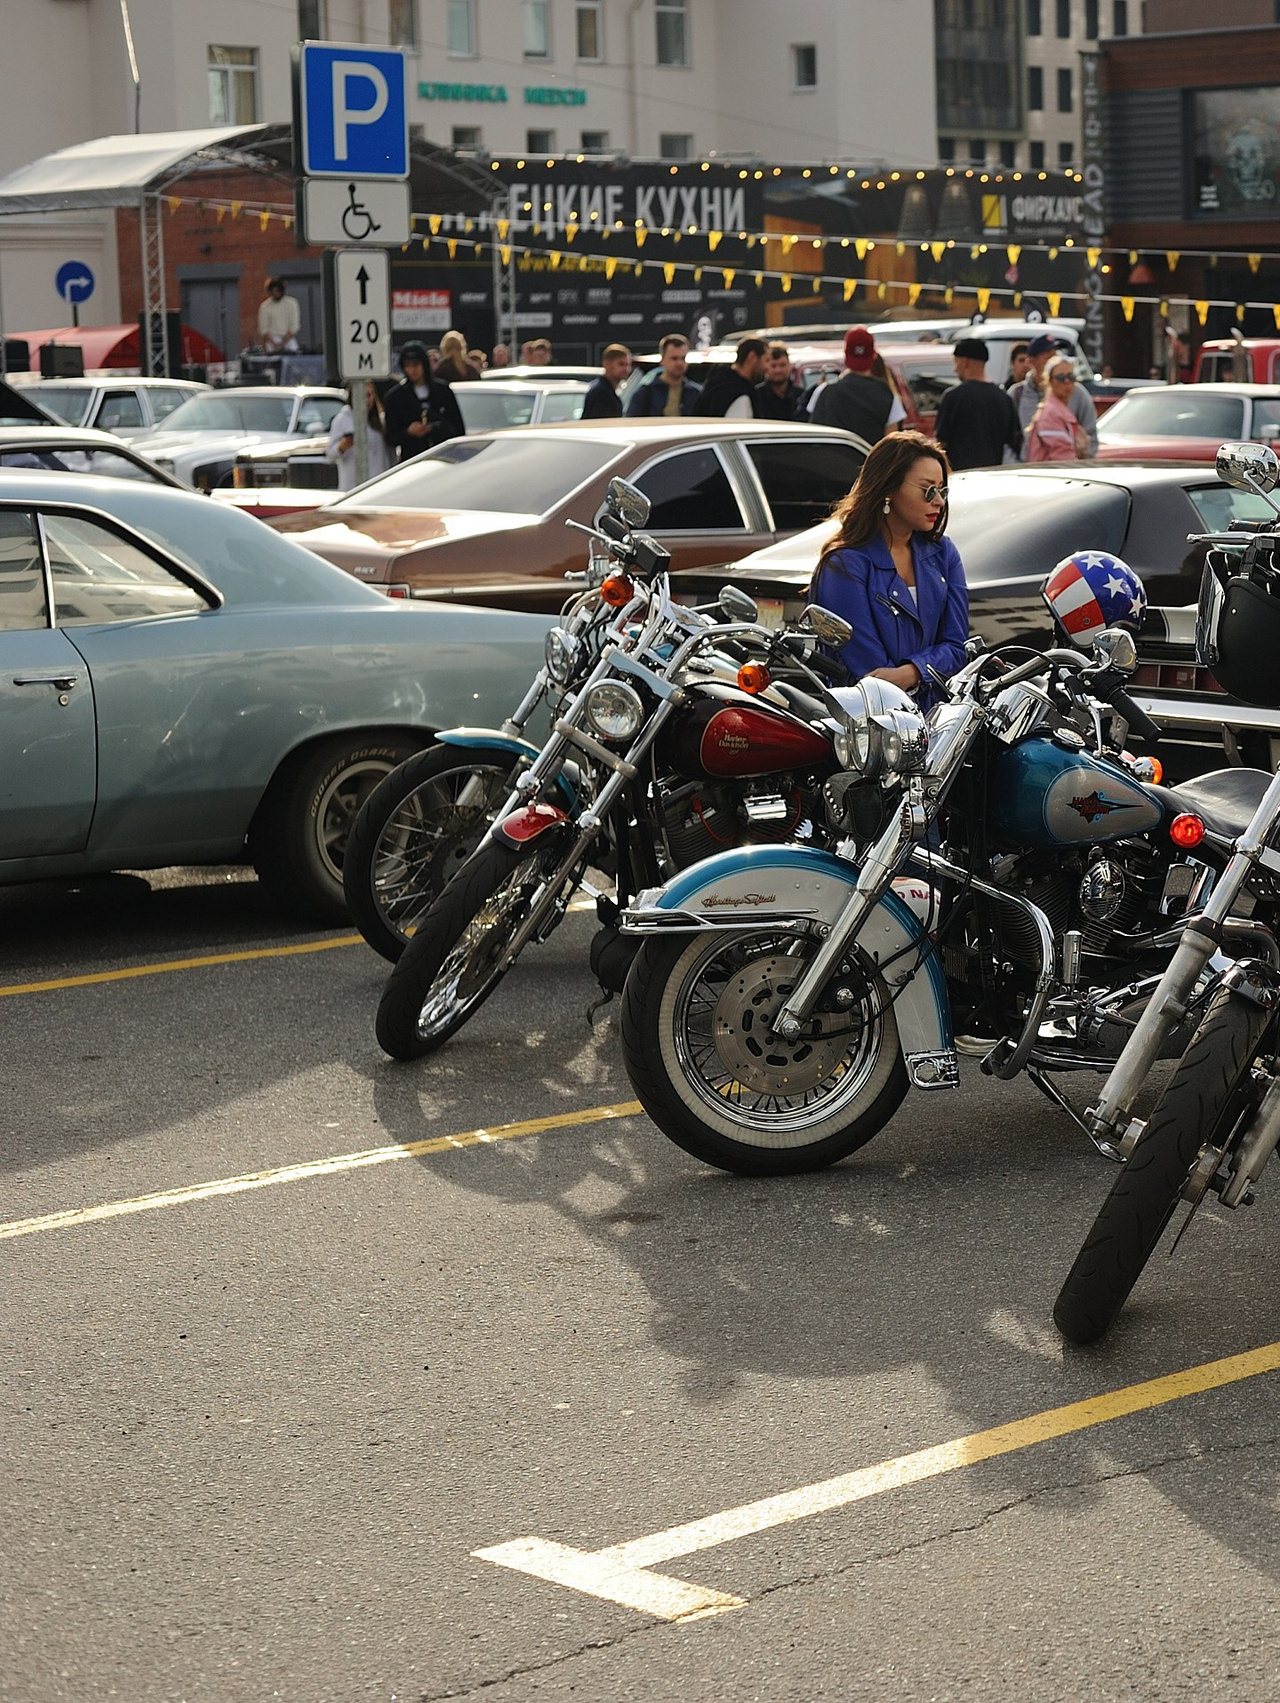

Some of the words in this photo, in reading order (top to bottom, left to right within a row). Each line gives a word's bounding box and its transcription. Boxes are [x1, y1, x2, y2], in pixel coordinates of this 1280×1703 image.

[418, 82, 508, 103] КЛИНИКА
[332, 60, 389, 161] P
[636, 186, 745, 232] КУХНИ
[393, 291, 450, 306] Miele
[350, 319, 379, 343] 20
